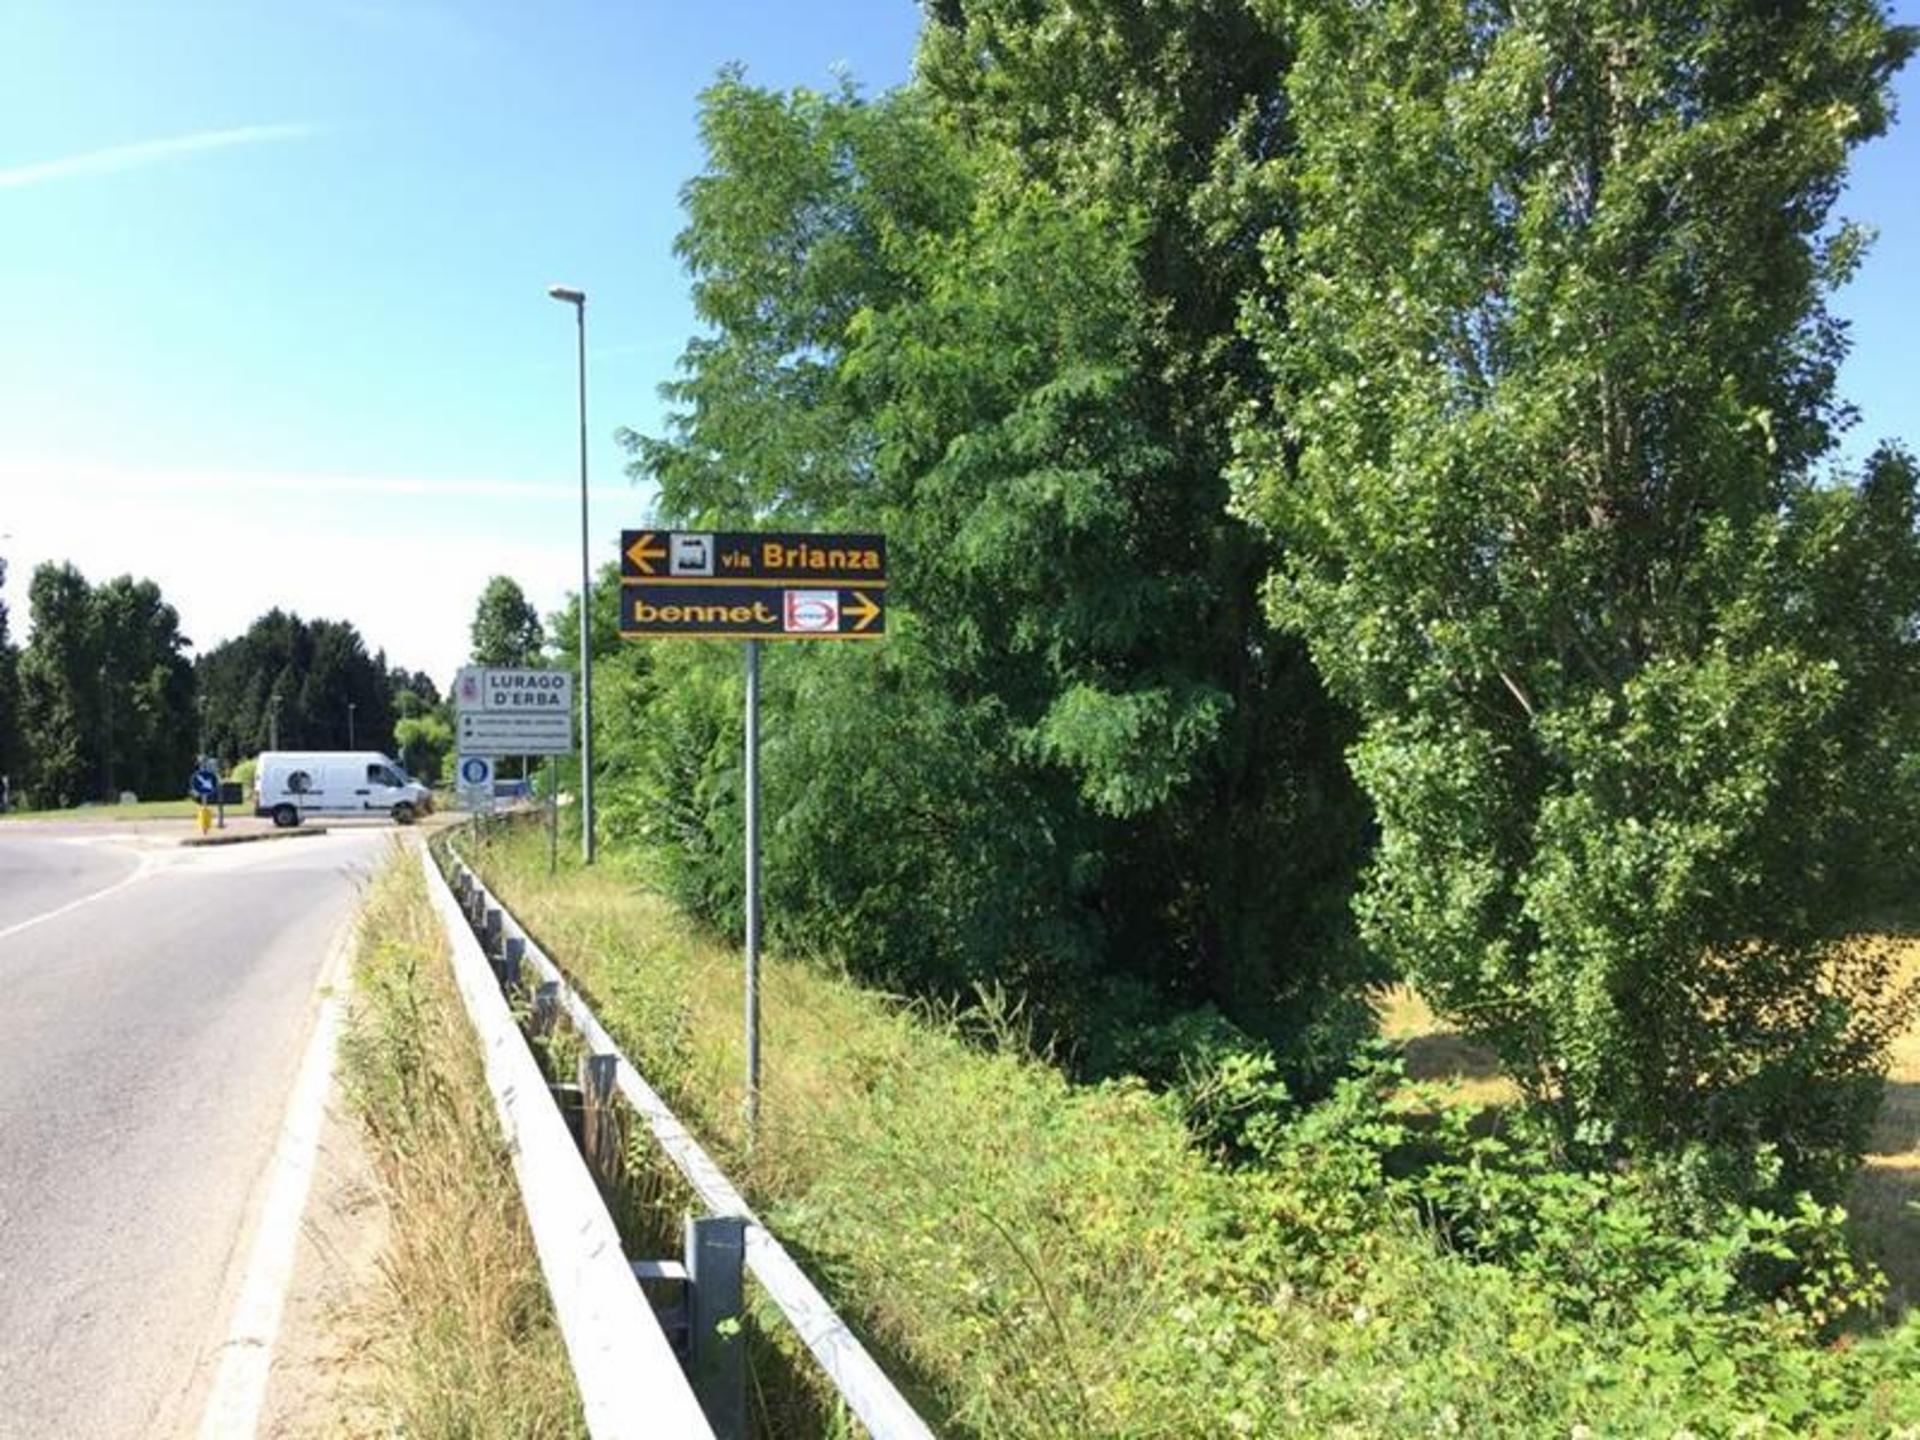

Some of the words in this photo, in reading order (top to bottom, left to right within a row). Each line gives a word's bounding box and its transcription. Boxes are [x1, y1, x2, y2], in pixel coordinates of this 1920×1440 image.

[722, 550, 751, 567] via
[763, 543, 880, 569] Brianza
[634, 600, 778, 623] bennet
[491, 675, 565, 689] LURAGO
[494, 692, 560, 705] D'ERBA
